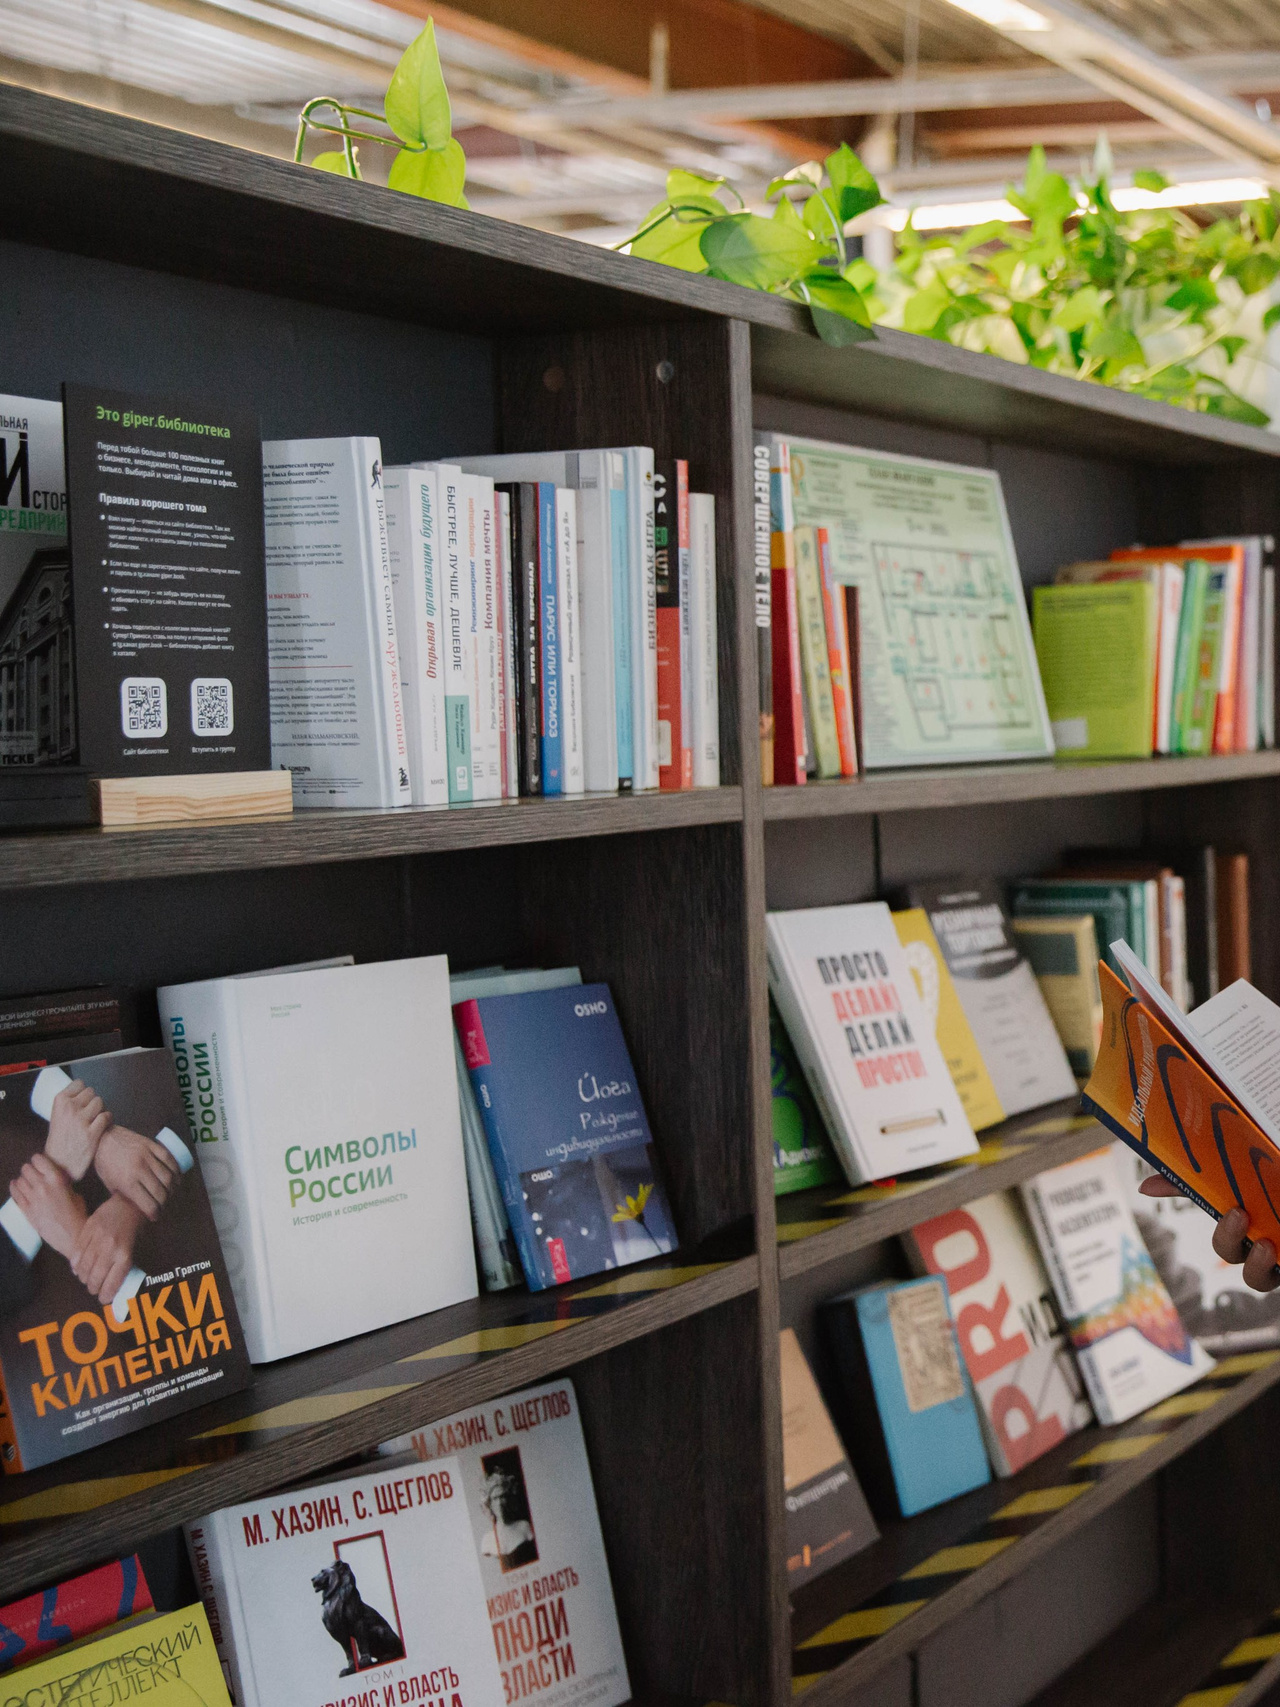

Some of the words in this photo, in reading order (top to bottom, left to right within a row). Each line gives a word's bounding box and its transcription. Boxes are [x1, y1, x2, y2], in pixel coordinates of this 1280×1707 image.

[96, 406, 120, 422] Это
[123, 411, 231, 439] giper.библиотека
[97, 441, 120, 453] Перед
[120, 445, 140, 455] тобой
[141, 447, 167, 458] больше
[168, 451, 179, 461] 100
[180, 453, 210, 464] полезных
[210, 458, 225, 466] книг
[98, 464, 124, 474] только.
[125, 467, 155, 479] Выбирай
[162, 473, 182, 482] читай
[183, 476, 200, 484] дома
[218, 480, 239, 489] офисе.
[104, 453, 133, 465] бизнесе,
[134, 457, 181, 471] менеджменте,
[182, 463, 219, 476] психологии
[99, 492, 140, 506] Правила
[141, 498, 184, 511] хорошего
[185, 503, 207, 513] тома
[419, 483, 434, 539] будущего
[446, 484, 458, 550] БЫСТРЕЕ,
[754, 444, 771, 577] СОВЕРШЕННОЕ
[483, 510, 492, 554] мечты
[646, 511, 655, 550] ИГРА
[375, 499, 390, 579] Выживает
[384, 585, 397, 636] самый
[423, 543, 437, 617] организации
[449, 553, 460, 604] ЛУЧШЕ,
[528, 561, 536, 620] ПЕРСОНАЛ
[646, 555, 656, 585] КАК
[484, 559, 493, 629] Компания
[755, 582, 772, 628] ТЕЛО
[450, 606, 463, 671] ДЕШЕВЛЕ
[529, 626, 535, 640] ЗА
[546, 595, 556, 642] ПАРУС
[647, 591, 657, 650] БИЗНЕС
[426, 621, 438, 679] Открывая
[547, 644, 557, 676] ИЛИ
[548, 679, 559, 738] ТОРМОЗ
[816, 951, 889, 986] ПРОСТО
[574, 1001, 608, 1018] OSHO
[844, 1013, 915, 1058] ДЕЛАЙ
[211, 1031, 224, 1097] современность
[578, 1071, 632, 1103] Йога
[192, 1042, 219, 1144] России
[220, 1106, 229, 1142] История
[284, 1128, 418, 1176] Символы
[289, 1164, 394, 1208] России
[292, 1209, 333, 1226] История
[334, 1207, 341, 1216] и
[342, 1191, 409, 1215] современность
[1160, 1166, 1216, 1217] ИДЕАЛЬНЫЙ
[145, 1267, 175, 1287] Линда
[175, 1260, 212, 1278] Граттон
[18, 1272, 225, 1378] ТОЧКИ
[31, 1319, 232, 1418] КИПЕНИЯ
[61, 1416, 98, 1436] создают
[98, 1404, 131, 1425] энергию
[131, 1400, 147, 1412] для
[147, 1388, 180, 1408] развития
[186, 1369, 225, 1391] инноваций
[75, 1410, 92, 1421] Как
[92, 1392, 143, 1415] организации,
[143, 1379, 170, 1397] группы
[176, 1366, 209, 1384] команды
[494, 1409, 510, 1438] С.
[510, 1388, 572, 1433] ЩЕГЛОВ
[241, 1514, 270, 1548] М.
[271, 1495, 350, 1541] ХАЗИН,
[352, 1490, 374, 1521] С.
[374, 1471, 455, 1519] ЩЕГЛОВ
[523, 1585, 532, 1607] И
[532, 1566, 579, 1602] ВЛАСТЬ
[363, 1670, 394, 1686] ТОМ
[399, 1664, 461, 1703] ВЛАСТЬ
